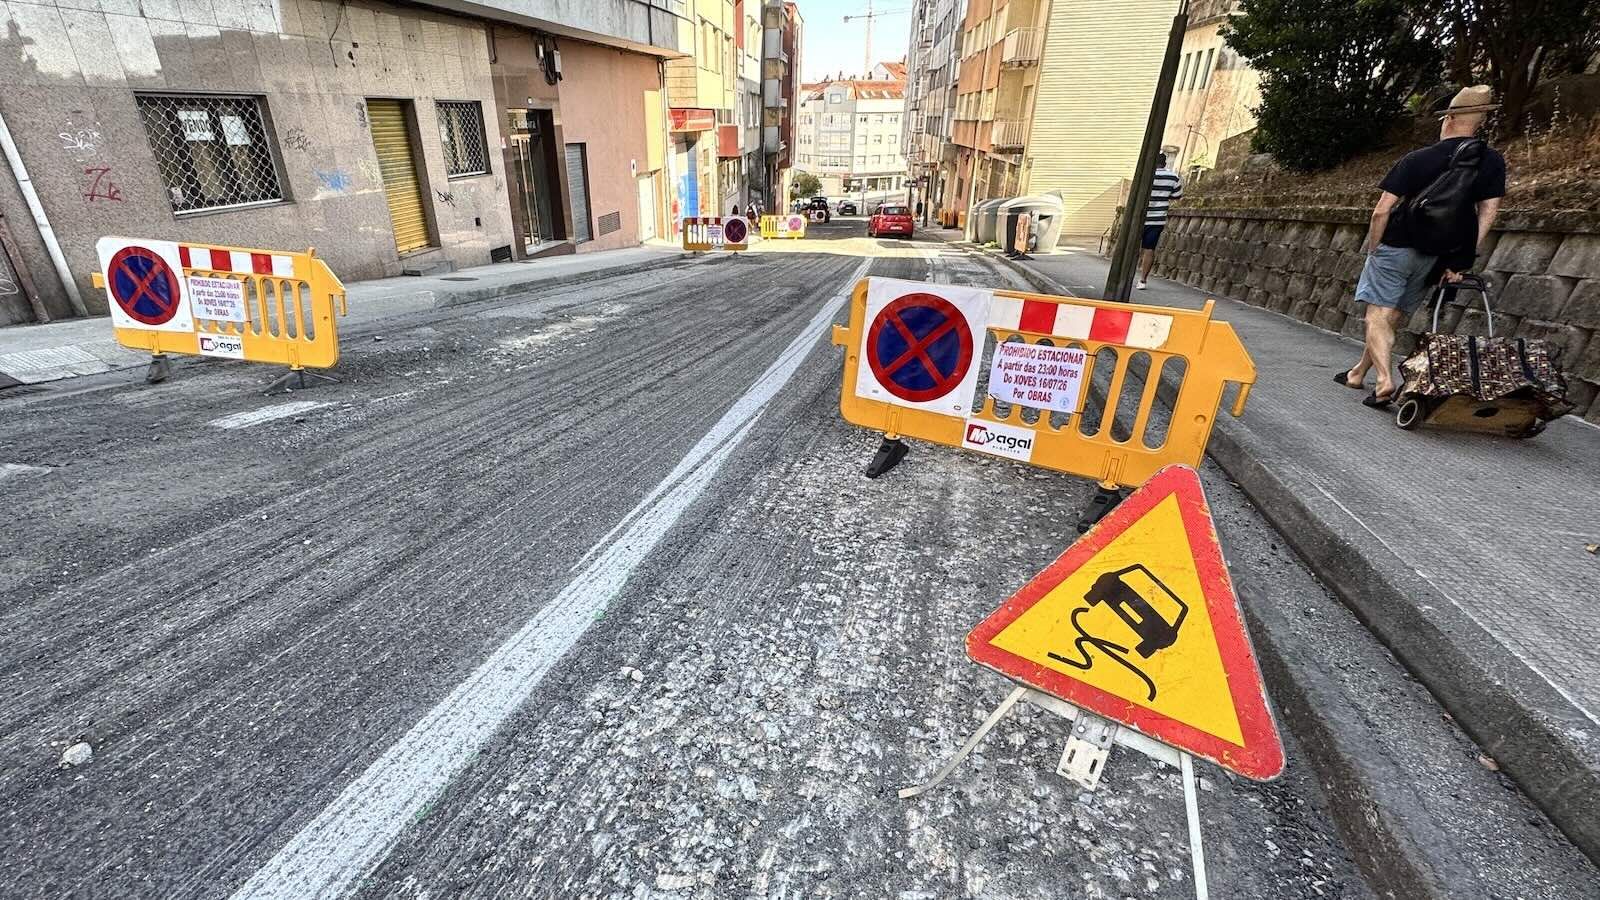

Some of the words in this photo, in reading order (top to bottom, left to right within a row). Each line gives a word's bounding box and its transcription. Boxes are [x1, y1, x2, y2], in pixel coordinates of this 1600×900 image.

[214, 308, 229, 316] OBRAS
[999, 344, 1037, 360] PROHIBIDO
[1037, 350, 1084, 365] ESTACIONAR
[997, 358, 1003, 369] A
[1003, 361, 1022, 372] partir
[1024, 362, 1037, 374] das
[1037, 364, 1057, 375] 23:00
[1058, 365, 1079, 379] horas
[1003, 373, 1013, 383] Do
[1013, 374, 1037, 388] XOVES
[1039, 378, 1068, 391] 16/07/26
[1013, 388, 1025, 399] Por
[1027, 390, 1053, 403] OBRAS
[967, 424, 1032, 449] Myagal
